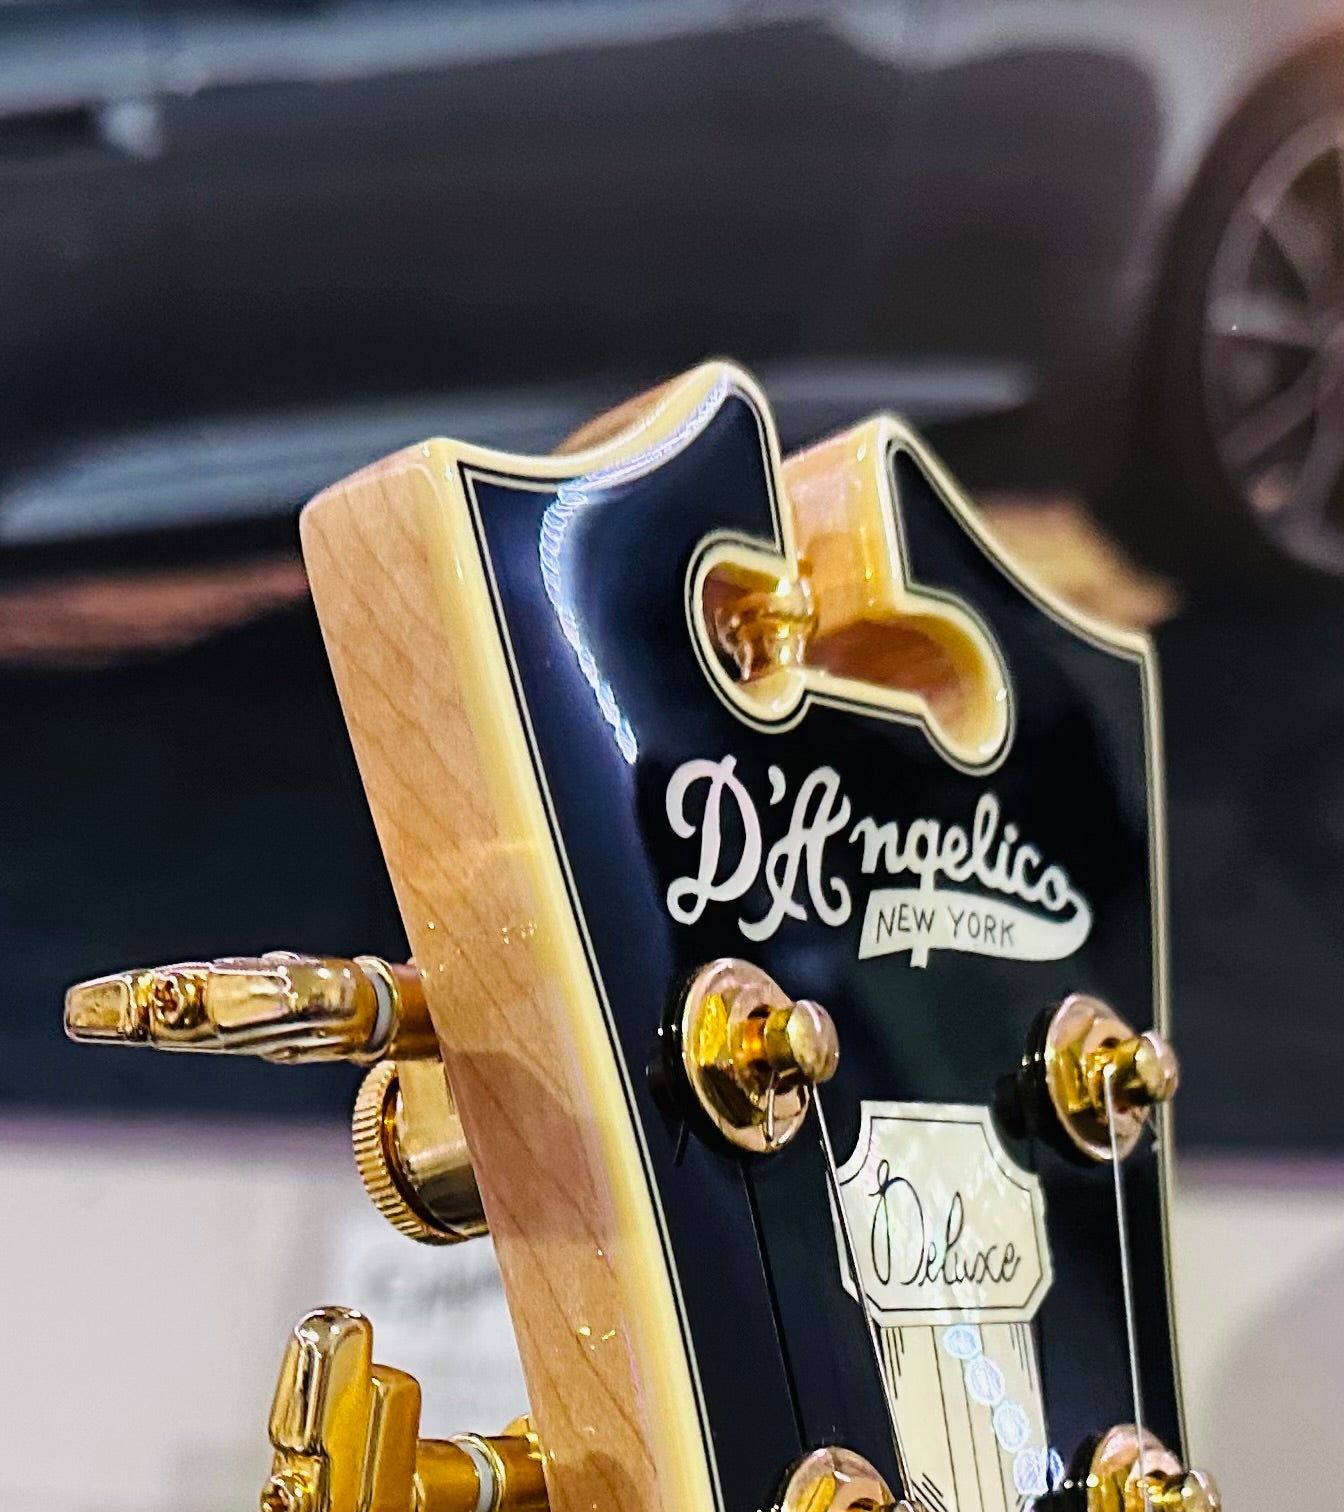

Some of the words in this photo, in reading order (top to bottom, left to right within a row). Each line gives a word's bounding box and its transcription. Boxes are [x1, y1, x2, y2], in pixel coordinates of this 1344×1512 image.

[665, 754, 1088, 943] D'Angelico
[876, 903, 936, 943] NEW
[947, 910, 1016, 947] YORK
[867, 1159, 1021, 1287] Deluxe
